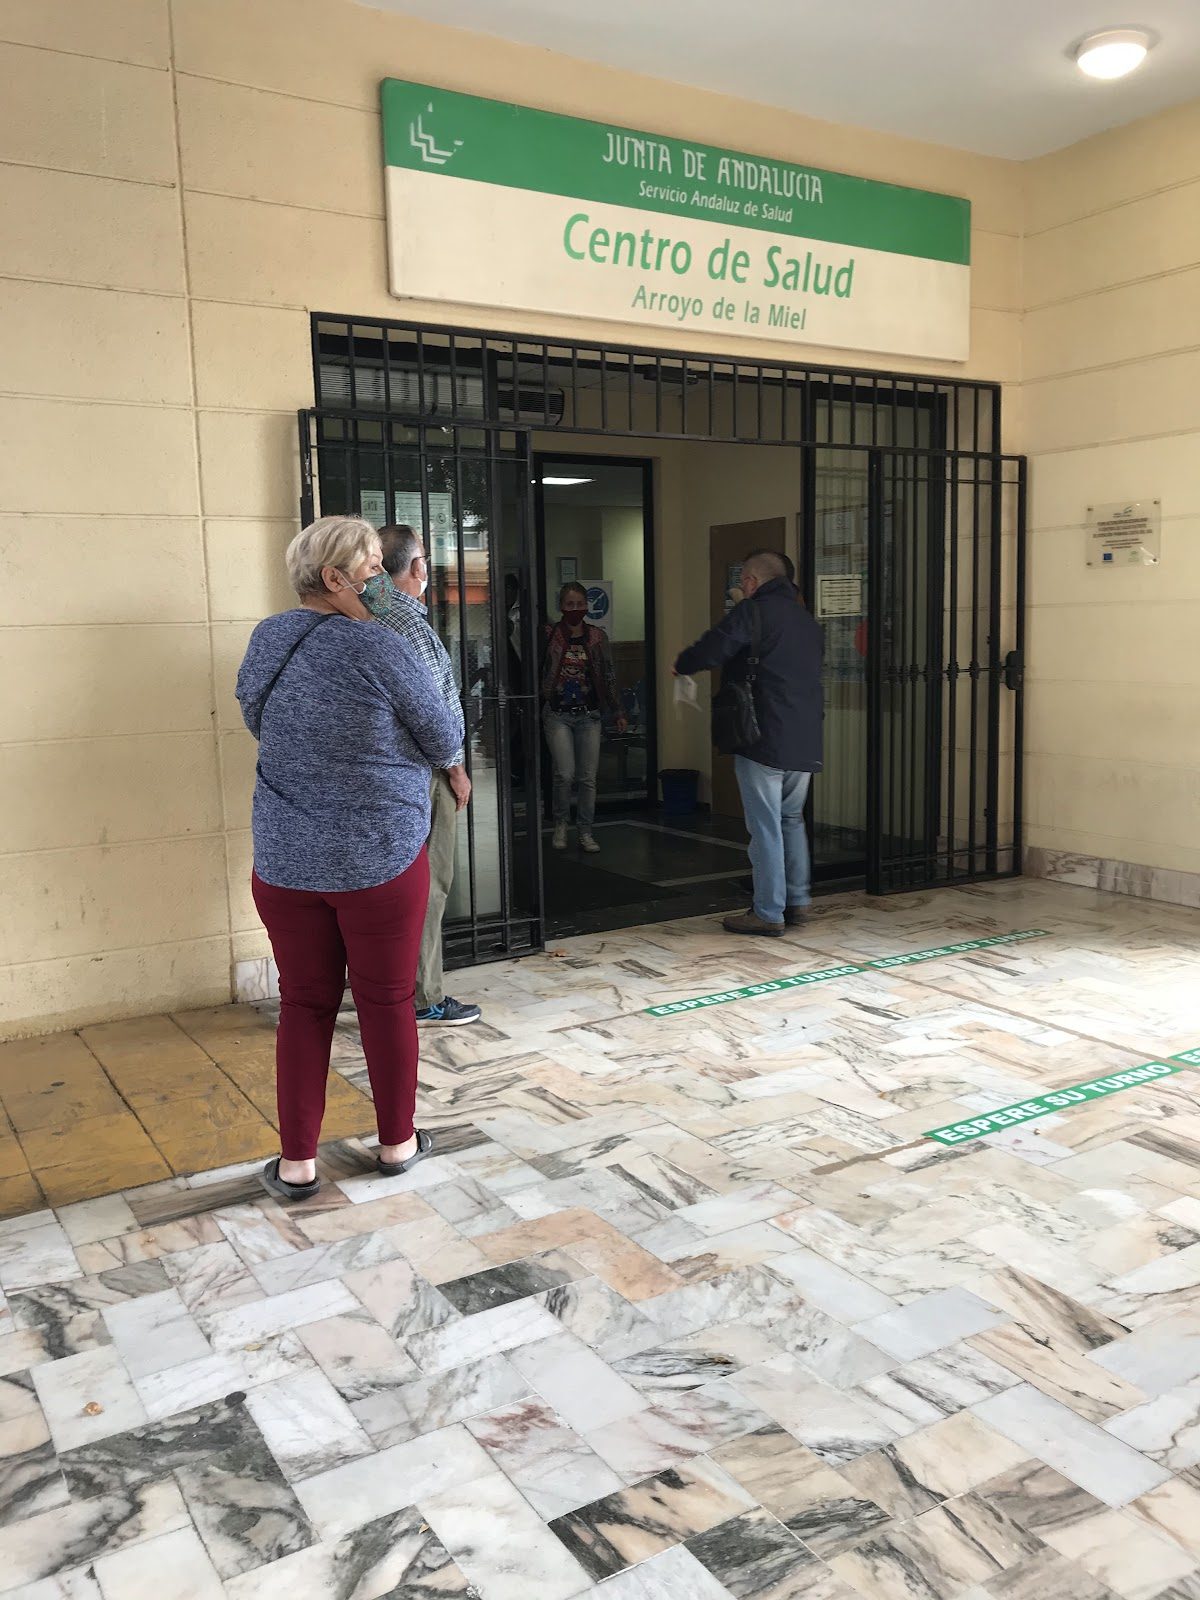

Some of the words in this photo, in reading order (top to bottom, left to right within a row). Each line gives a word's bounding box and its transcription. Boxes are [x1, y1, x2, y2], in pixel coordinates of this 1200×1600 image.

[602, 133, 672, 174] JUNTA
[682, 148, 707, 181] DE
[638, 180, 687, 204] Servicio
[690, 190, 740, 214] Andaluz
[743, 201, 758, 217] de
[761, 203, 793, 223] Salud
[563, 213, 692, 275] Centro
[707, 238, 750, 284] de
[763, 245, 855, 298] Salud
[631, 285, 703, 322] Arroyo
[712, 297, 736, 321] de
[744, 301, 760, 324] la
[768, 304, 807, 330] Miel
[872, 947, 951, 968] ESPERE
[950, 943, 977, 952] SU
[979, 929, 1046, 946] TURNO
[654, 990, 748, 1015] ESPERE
[747, 982, 782, 995] SU
[783, 966, 860, 986] TURNO
[935, 1101, 1049, 1142] ESPERE
[1043, 1089, 1087, 1106] SU
[1084, 1064, 1172, 1094] TURNO
